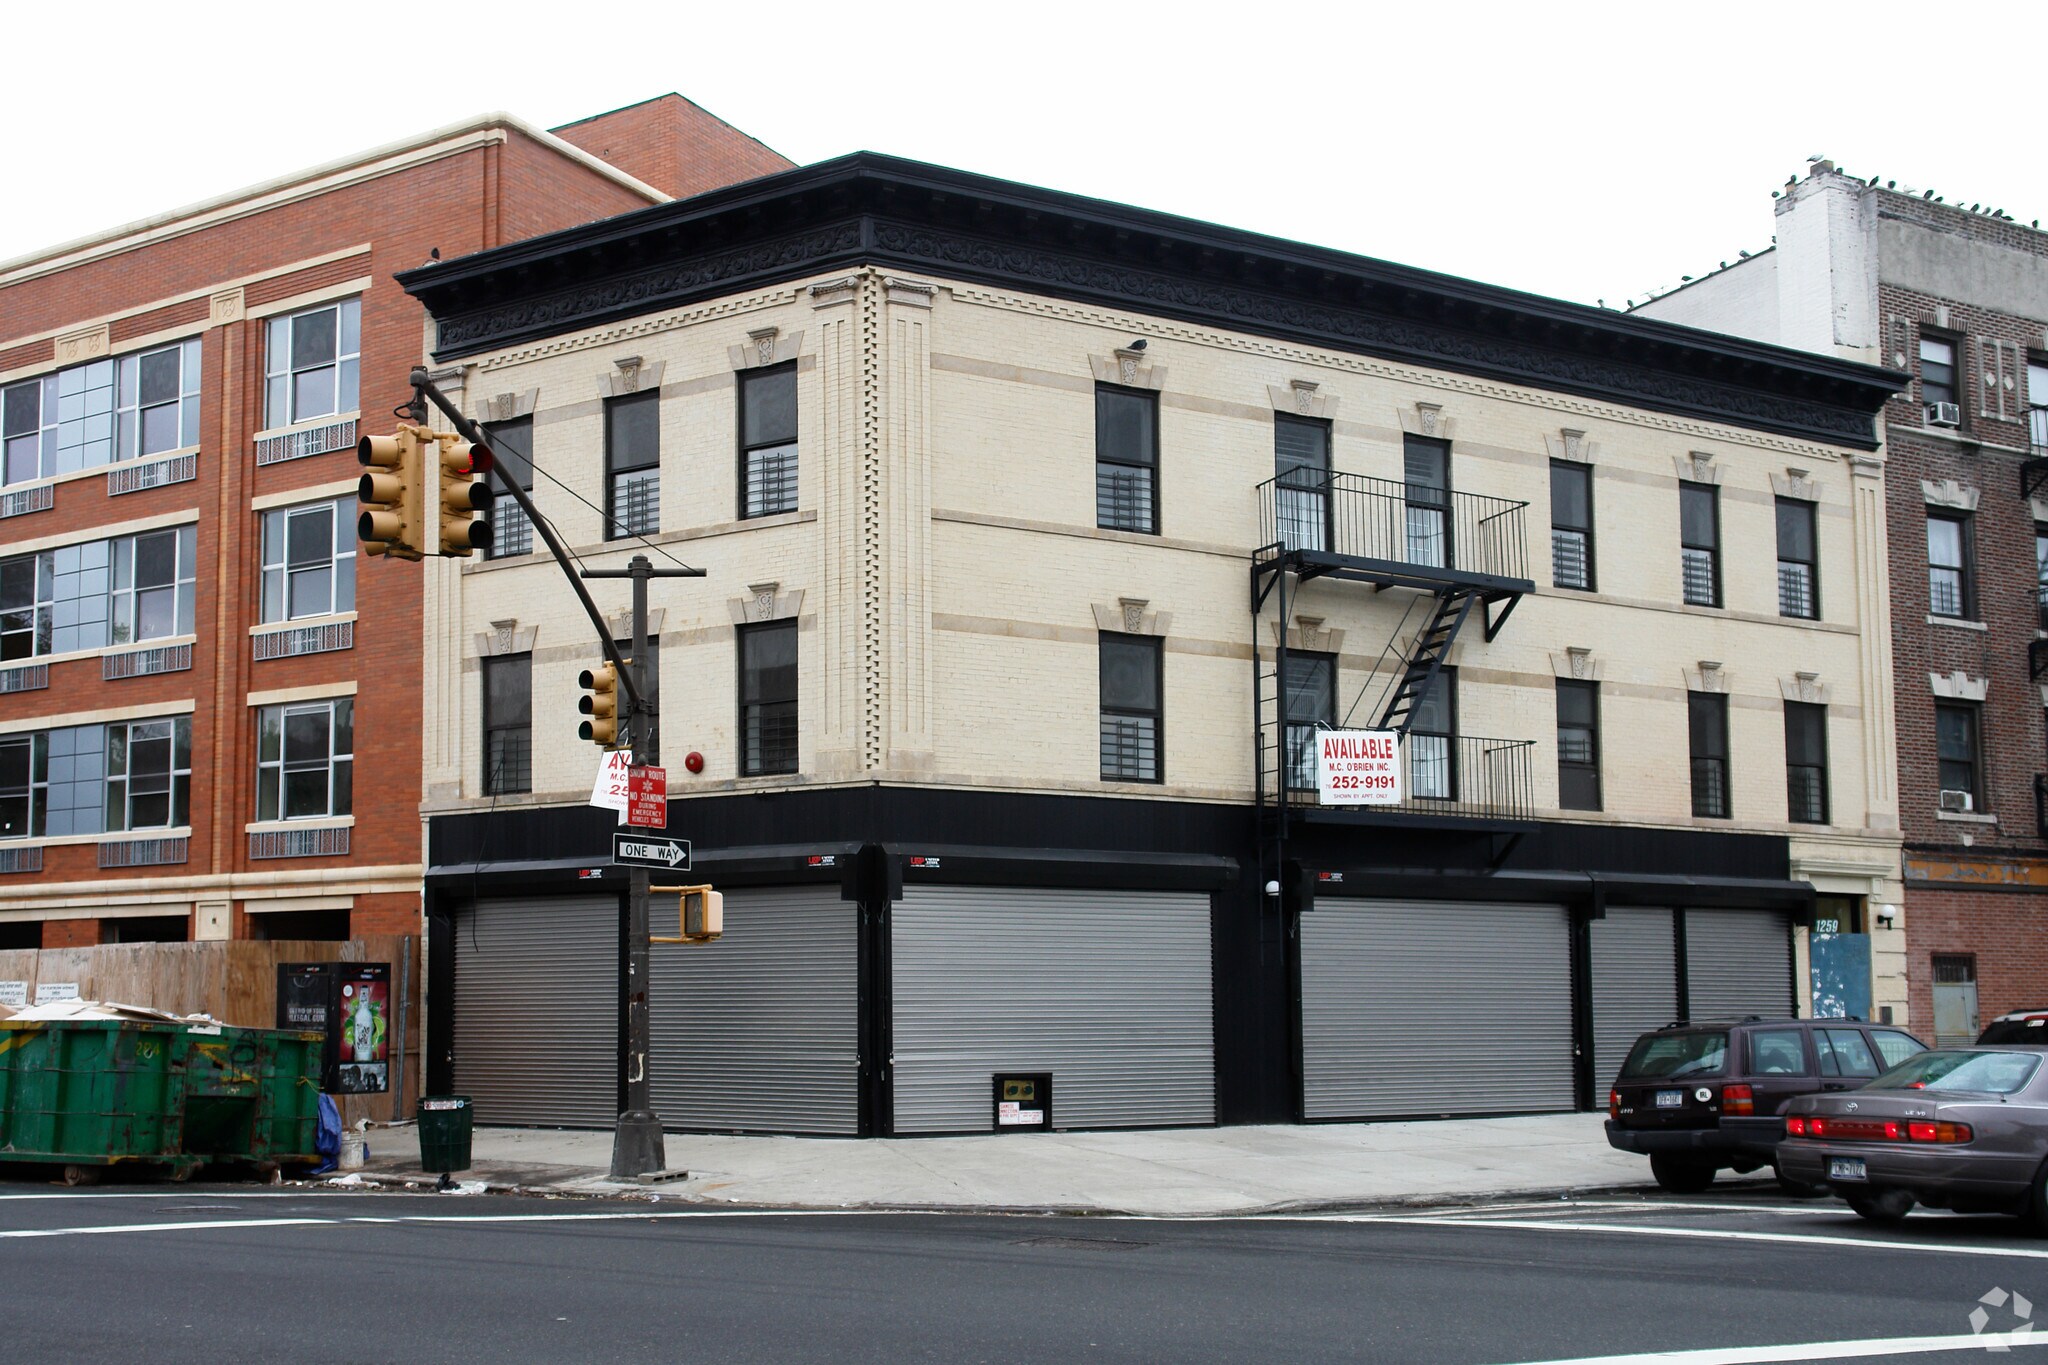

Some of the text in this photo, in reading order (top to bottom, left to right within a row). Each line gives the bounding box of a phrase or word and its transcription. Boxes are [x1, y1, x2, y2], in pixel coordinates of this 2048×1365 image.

[1324, 738, 1393, 759] AVAILABLE
[1329, 763, 1390, 771] M.C. O'BRIEN INC.
[630, 768, 664, 780] SNOW ROUTE
[1332, 776, 1395, 788] 252-9191
[630, 792, 664, 804] NO STANDING
[638, 802, 656, 810] DURING
[632, 808, 662, 817] EMERGENCY
[625, 844, 679, 860] ONE WAY
[1816, 920, 1838, 932] 1259
